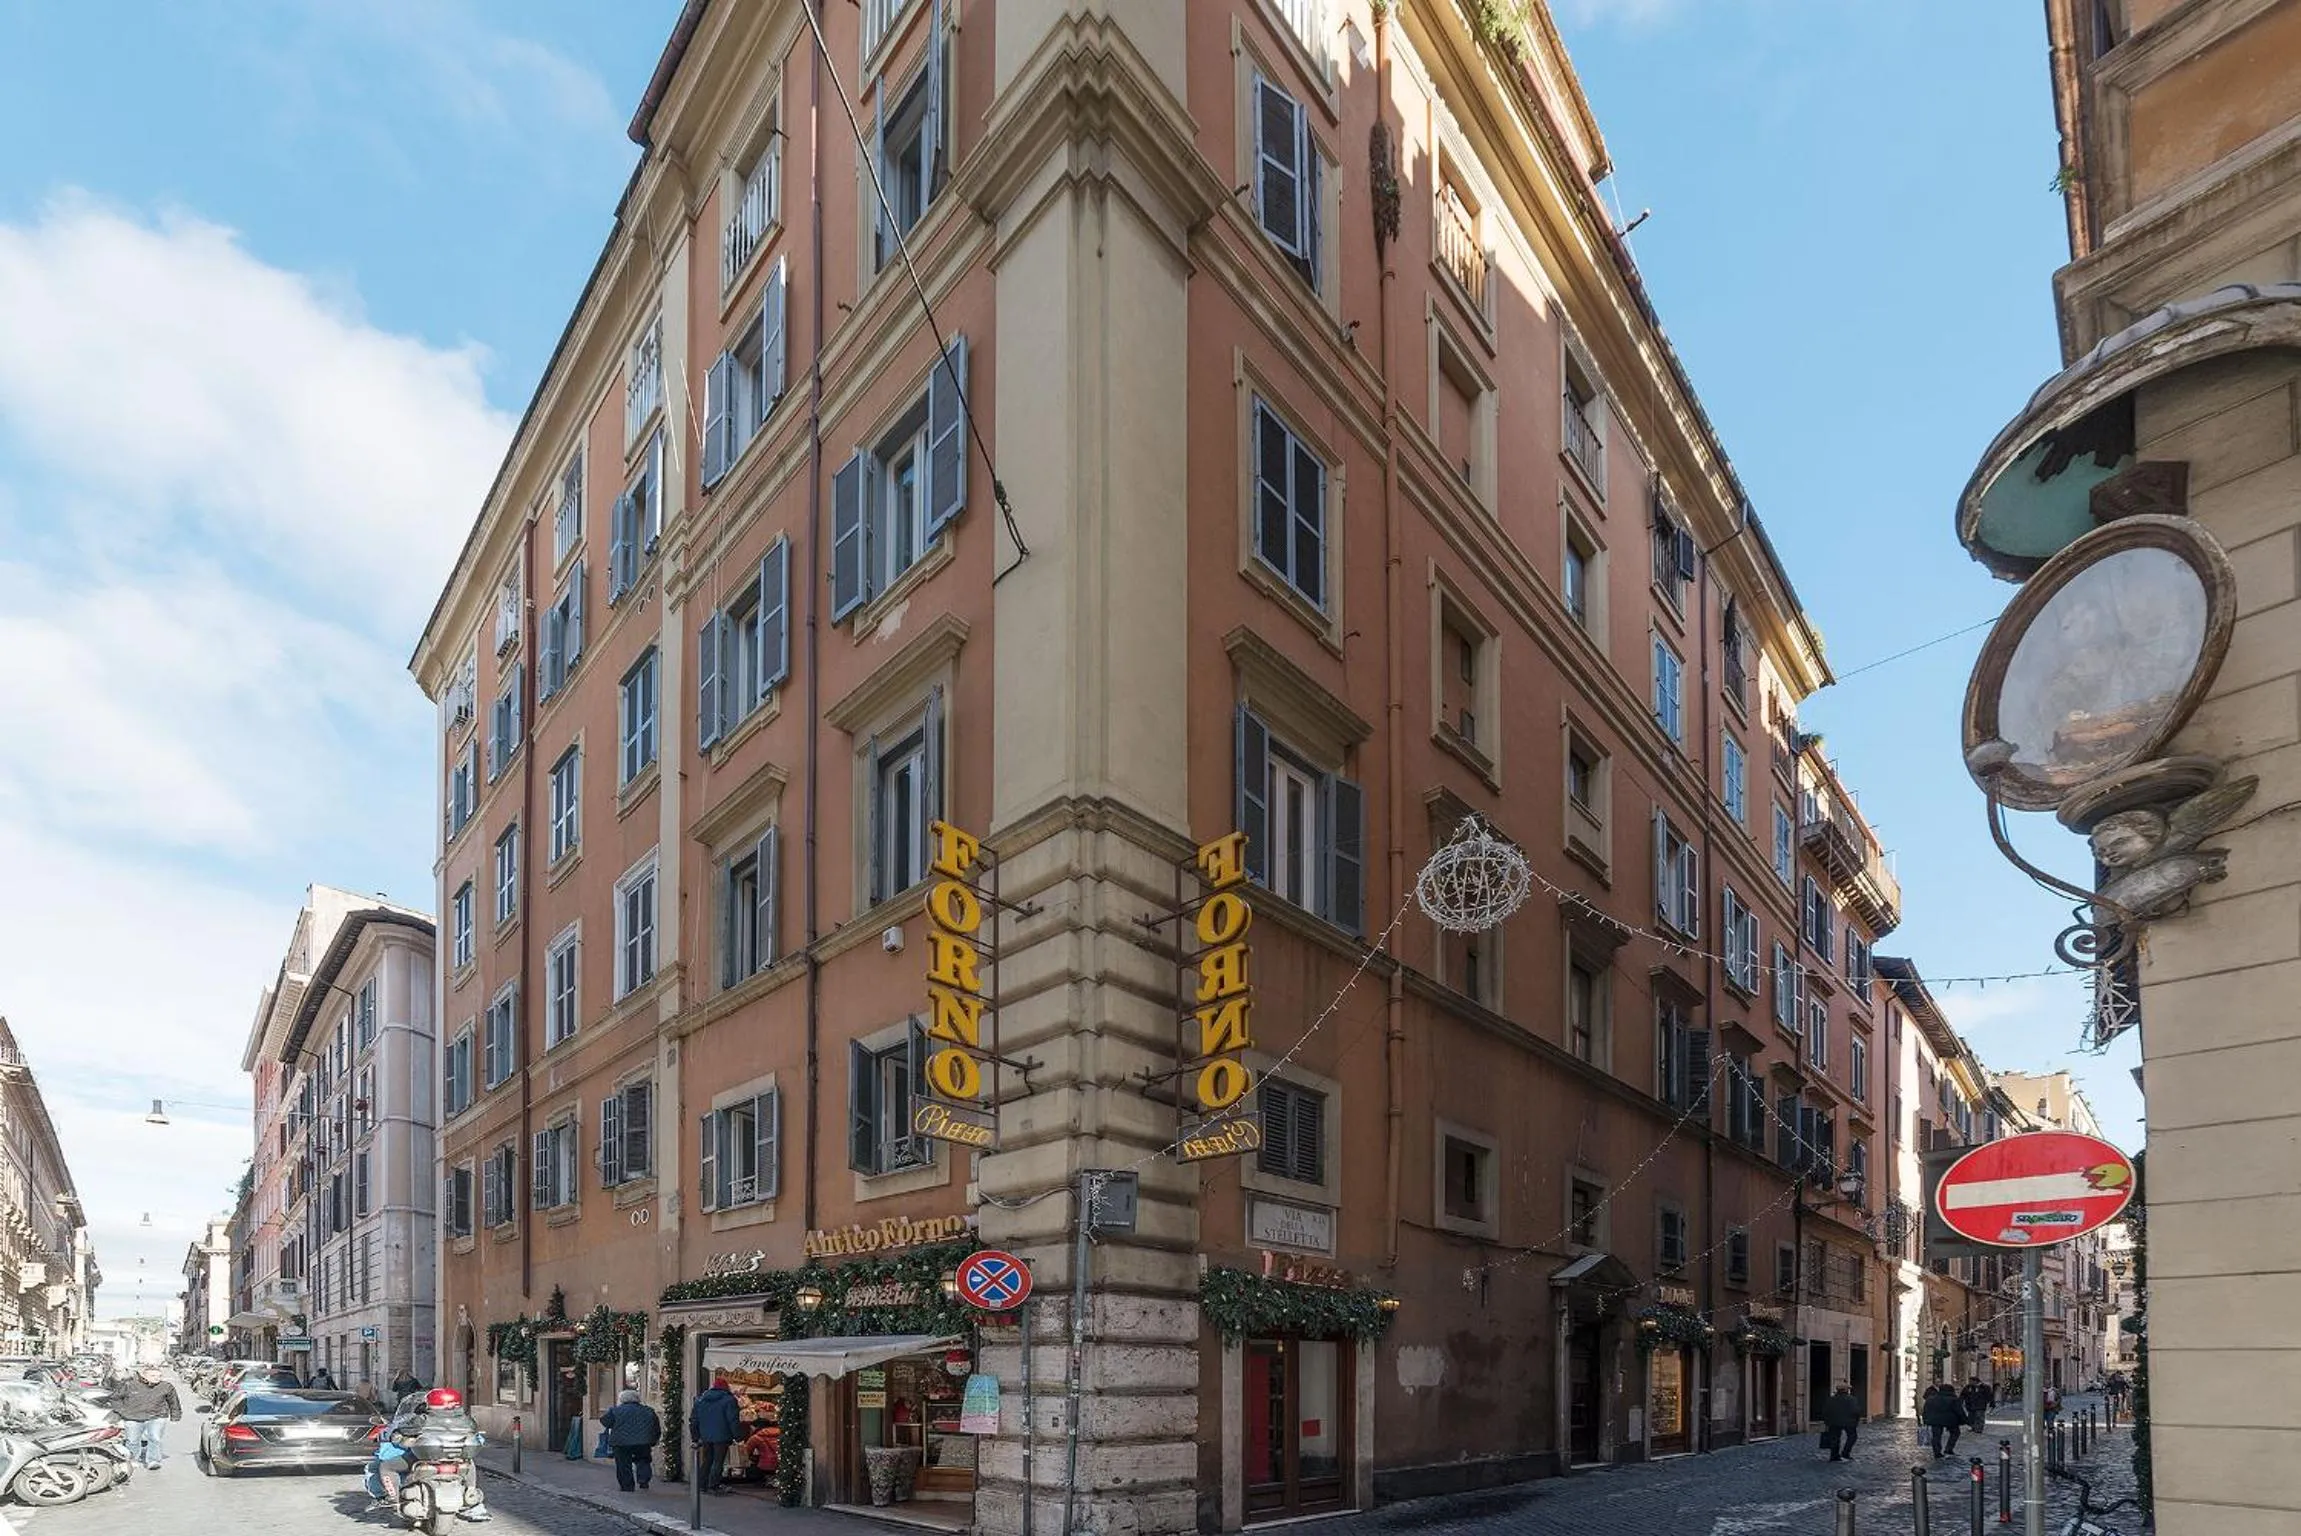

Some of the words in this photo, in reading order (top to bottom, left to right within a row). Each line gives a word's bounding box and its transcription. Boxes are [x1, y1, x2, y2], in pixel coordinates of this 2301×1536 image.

[926, 819, 984, 1100] FORNO
[915, 1104, 993, 1145] Pizza
[1280, 1219, 1305, 1231] DELLA
[1284, 1208, 1302, 1223] VIA
[1263, 1227, 1320, 1246] STELLETTA
